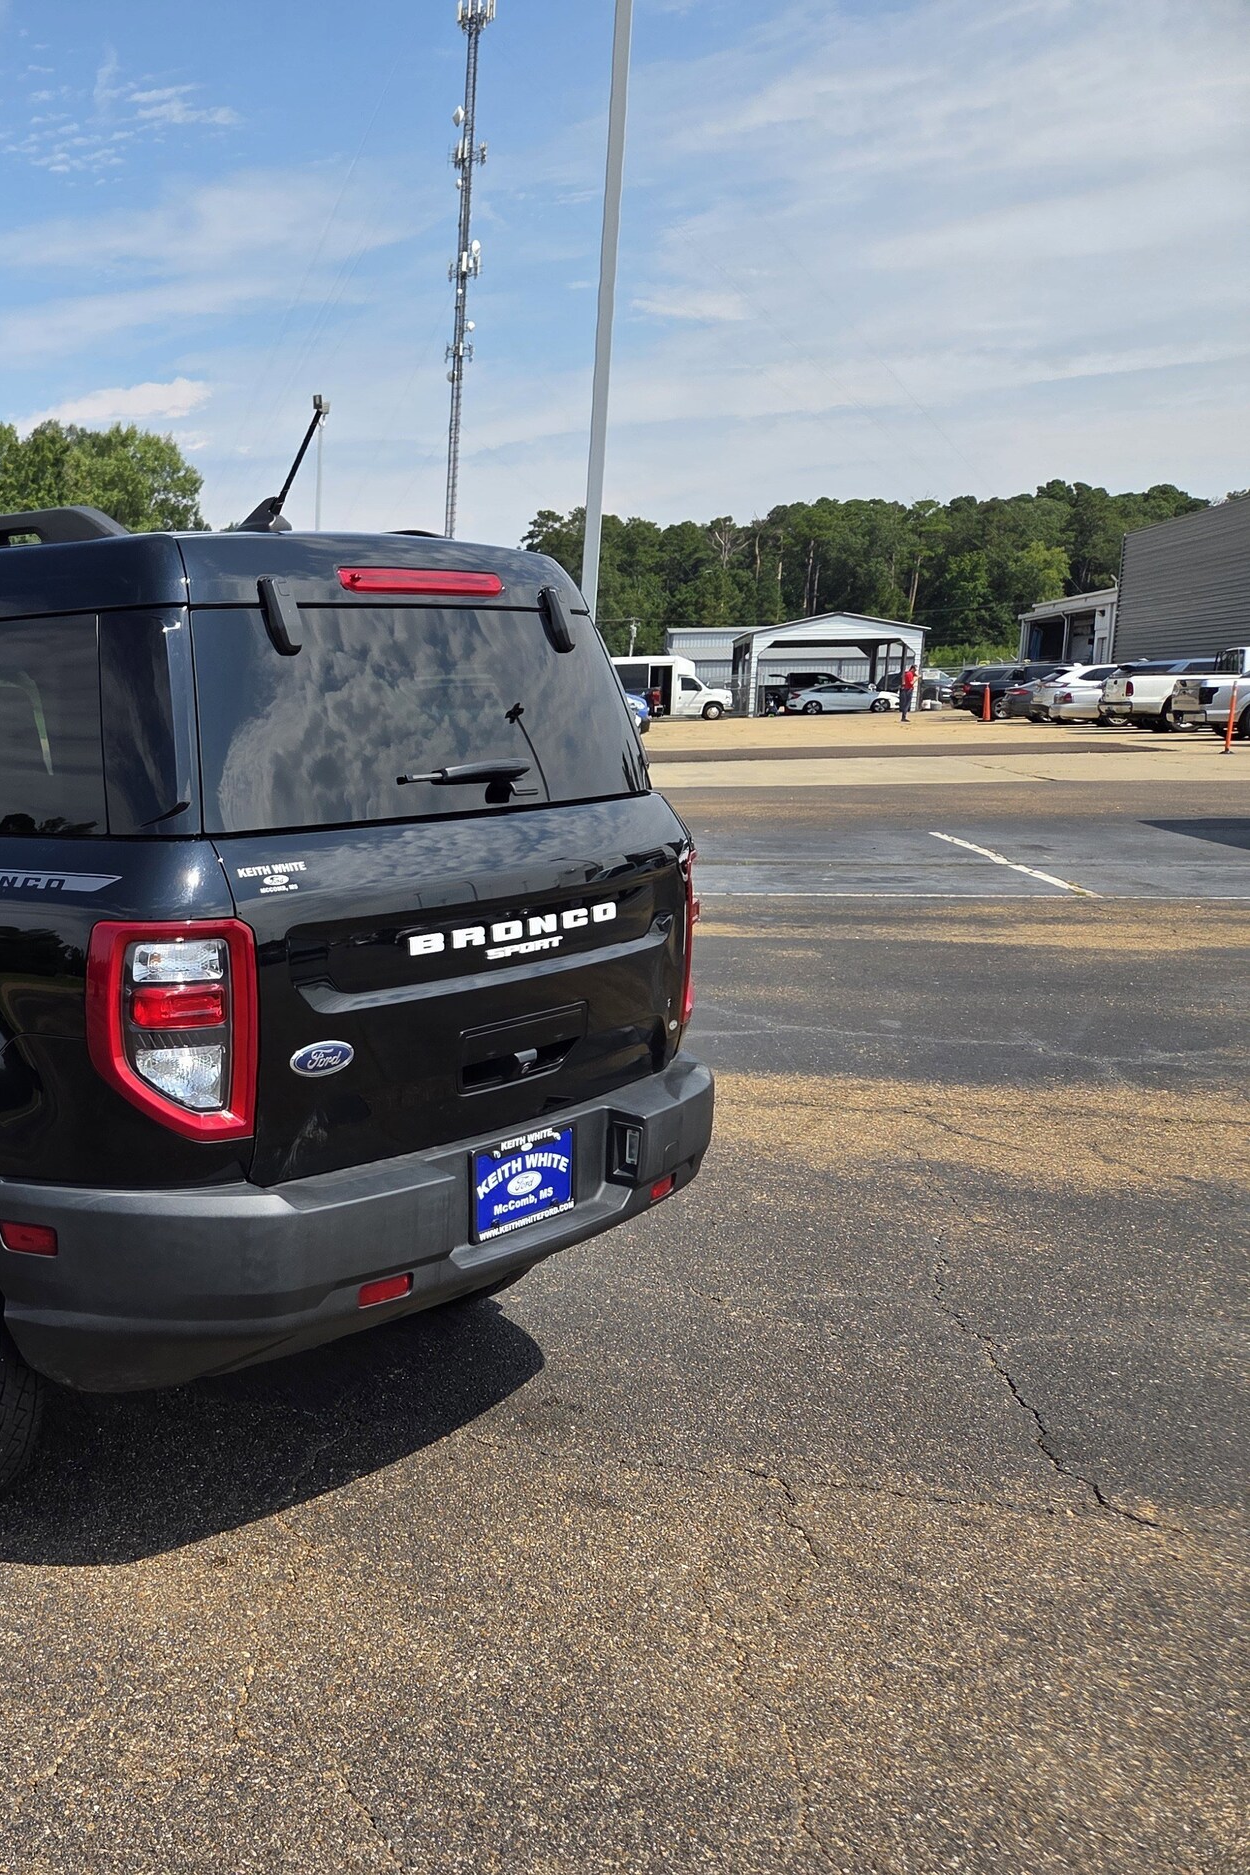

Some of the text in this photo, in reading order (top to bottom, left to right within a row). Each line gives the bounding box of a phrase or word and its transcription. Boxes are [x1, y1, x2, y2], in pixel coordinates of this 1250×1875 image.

[237, 861, 307, 878] KEITH WHITE
[407, 901, 617, 957] BRONCO
[484, 936, 564, 960] SPORT
[307, 1048, 342, 1069] Ford
[500, 1127, 553, 1152] KEITH WHITE
[476, 1152, 569, 1200] KEITH WHITE
[493, 1186, 554, 1216] McComb, MS
[479, 1201, 575, 1242] WWW.KEITHWHITEFORD.COM
